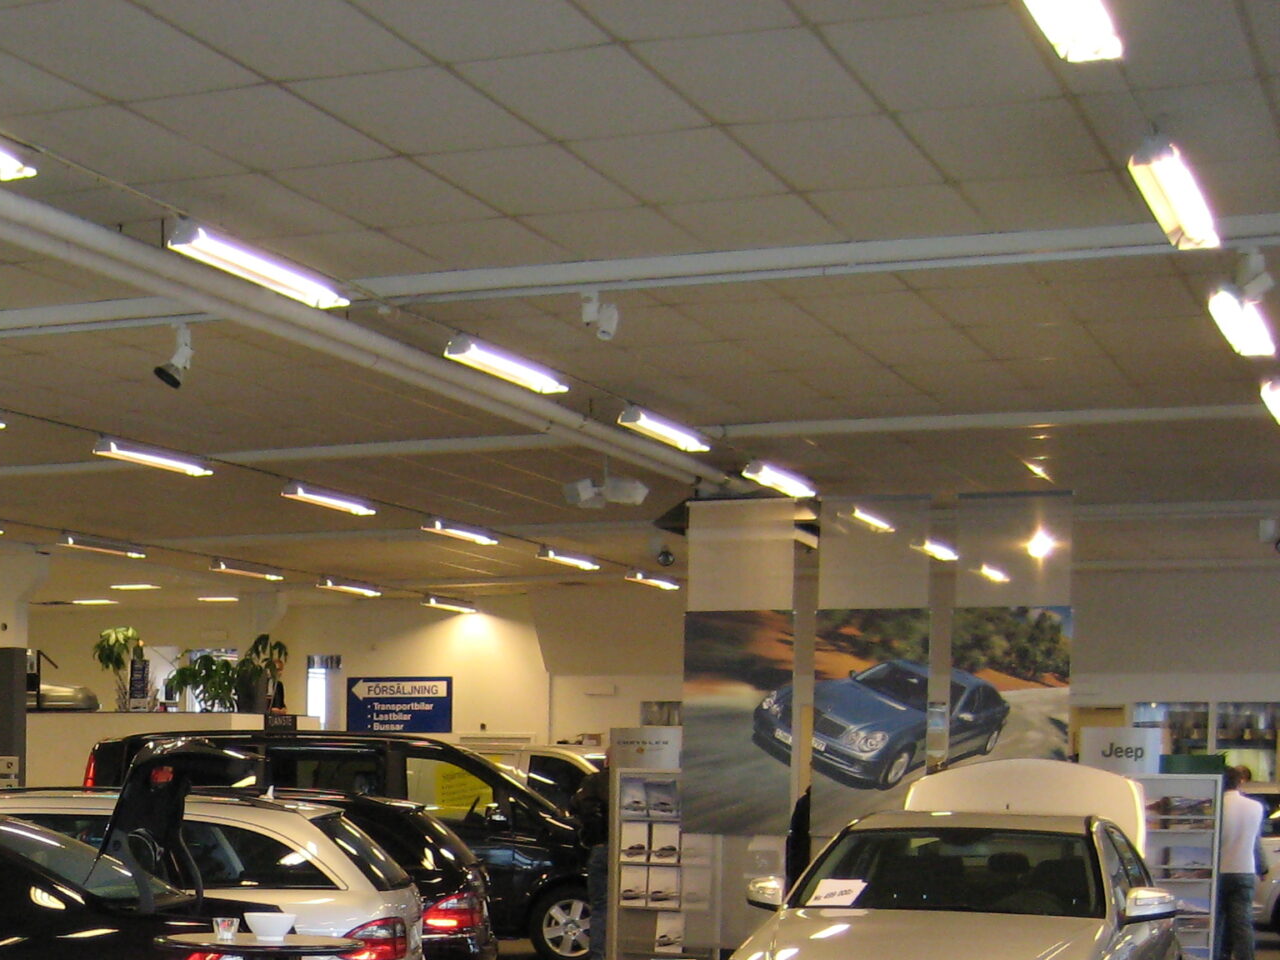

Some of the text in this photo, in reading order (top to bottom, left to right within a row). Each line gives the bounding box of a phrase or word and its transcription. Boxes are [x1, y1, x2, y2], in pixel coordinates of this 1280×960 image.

[367, 683, 439, 696] FÖRSÄLJNING
[373, 702, 434, 712] Transportbilar
[373, 712, 412, 721] Lastbilar
[373, 722, 404, 731] Bussar
[1101, 742, 1145, 762] Jeep
